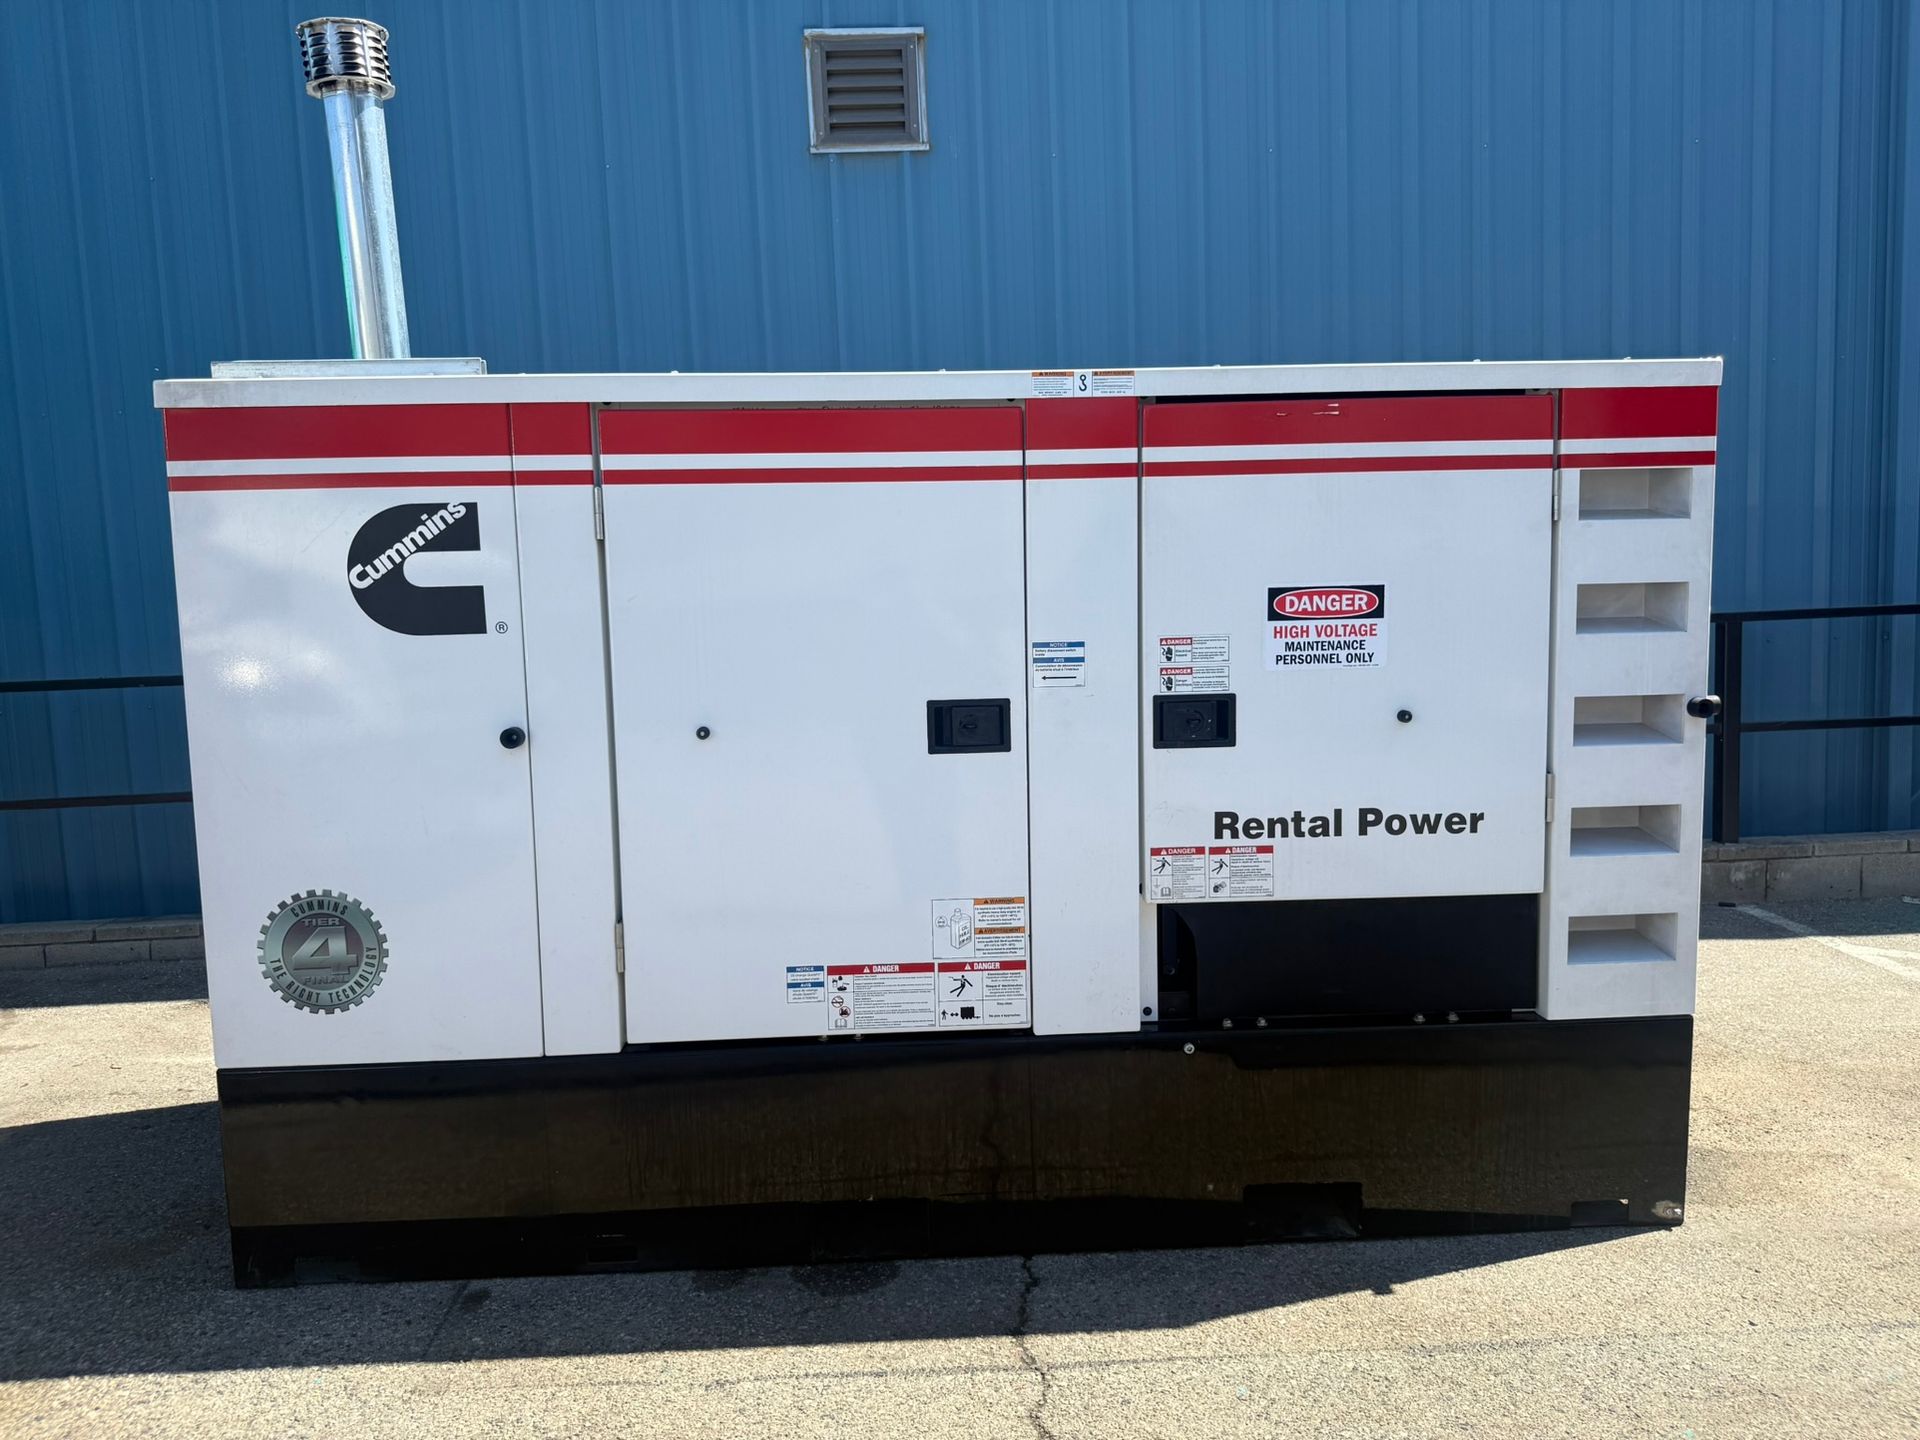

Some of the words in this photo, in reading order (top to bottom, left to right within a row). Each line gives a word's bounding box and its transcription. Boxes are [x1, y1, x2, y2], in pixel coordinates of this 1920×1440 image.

[348, 502, 467, 589] Cummins
[1285, 593, 1368, 612] DANGER
[1273, 625, 1310, 639] HIGH
[1314, 623, 1378, 638] VOLTAGE
[1284, 639, 1366, 652] MAINTENANCE
[1275, 653, 1342, 665] PERSONNEL
[1346, 652, 1375, 664] ONLY
[1214, 808, 1343, 840] Rental
[1358, 807, 1484, 836] Power
[290, 899, 348, 918] CUMMINS
[301, 917, 340, 927] TIER
[291, 925, 359, 975] 4
[269, 958, 287, 980] THE
[285, 980, 321, 1003] RIGHT
[328, 946, 377, 1003] TECHNOLOGY
[973, 962, 1000, 970] DANGER
[303, 976, 349, 985] FINAL
